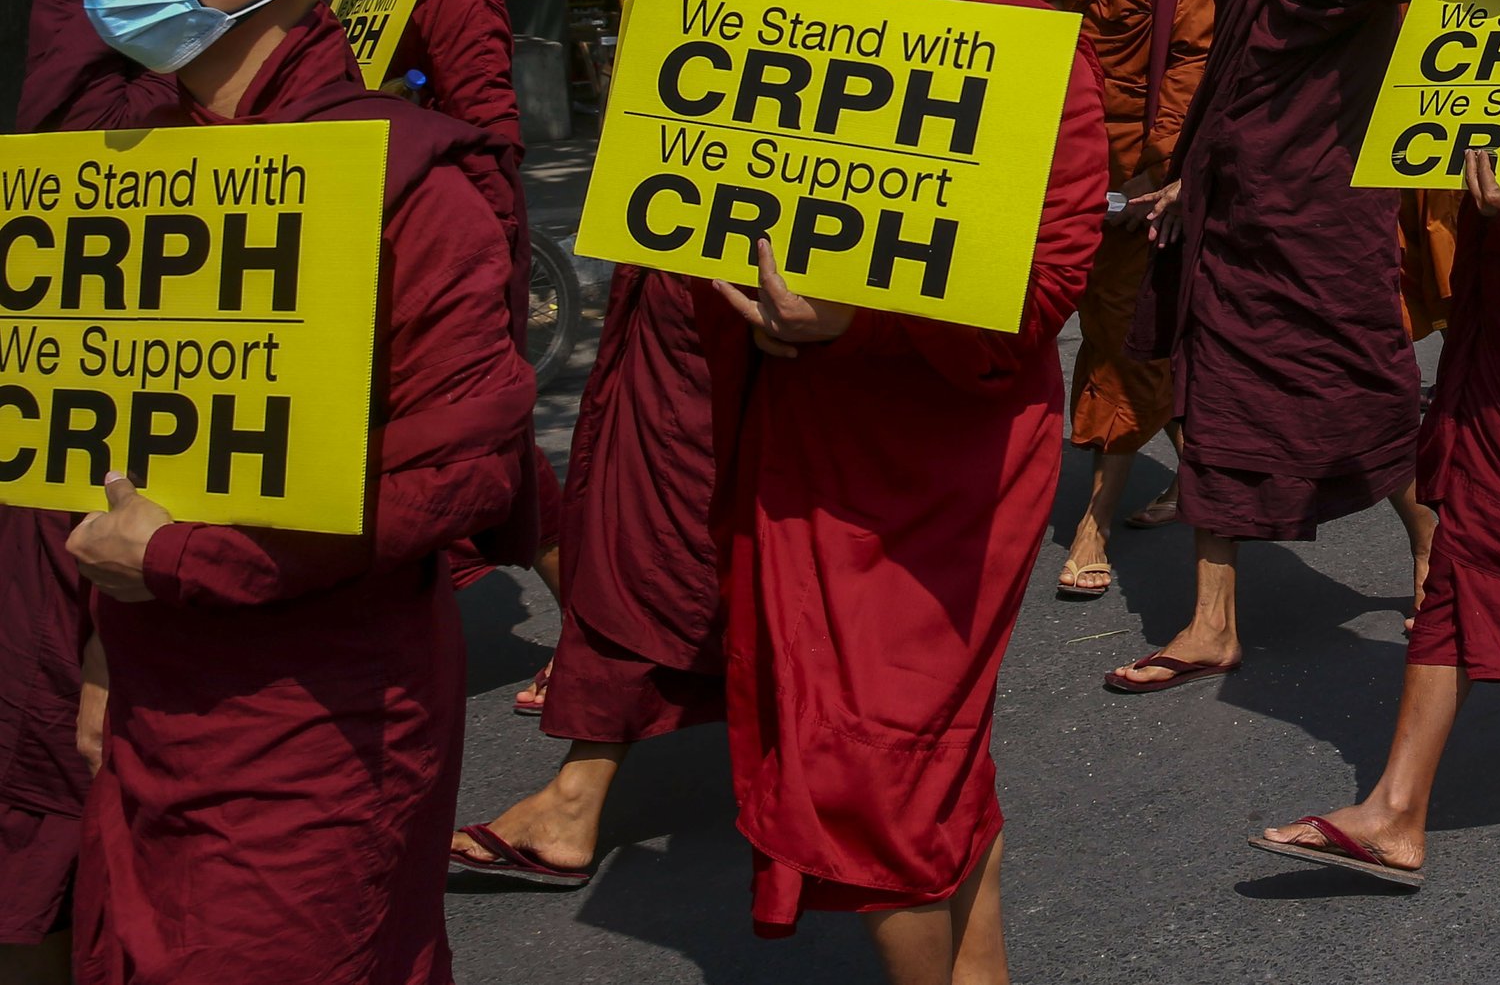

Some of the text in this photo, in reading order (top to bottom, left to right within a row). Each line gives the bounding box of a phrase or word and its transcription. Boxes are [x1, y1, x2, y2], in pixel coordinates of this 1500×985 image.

[341, 13, 391, 60] PH
[757, 5, 888, 59] Stand
[902, 27, 997, 73] with
[1440, 3, 1488, 30] We
[656, 40, 989, 156] CRPH
[1418, 89, 1470, 117] We
[2, 155, 306, 211] We Stand with
[659, 125, 954, 209] We Support
[0, 212, 303, 312] CRPH
[625, 172, 960, 300] CRPH
[0, 326, 281, 390] We Support
[0, 384, 292, 499] CRPH
